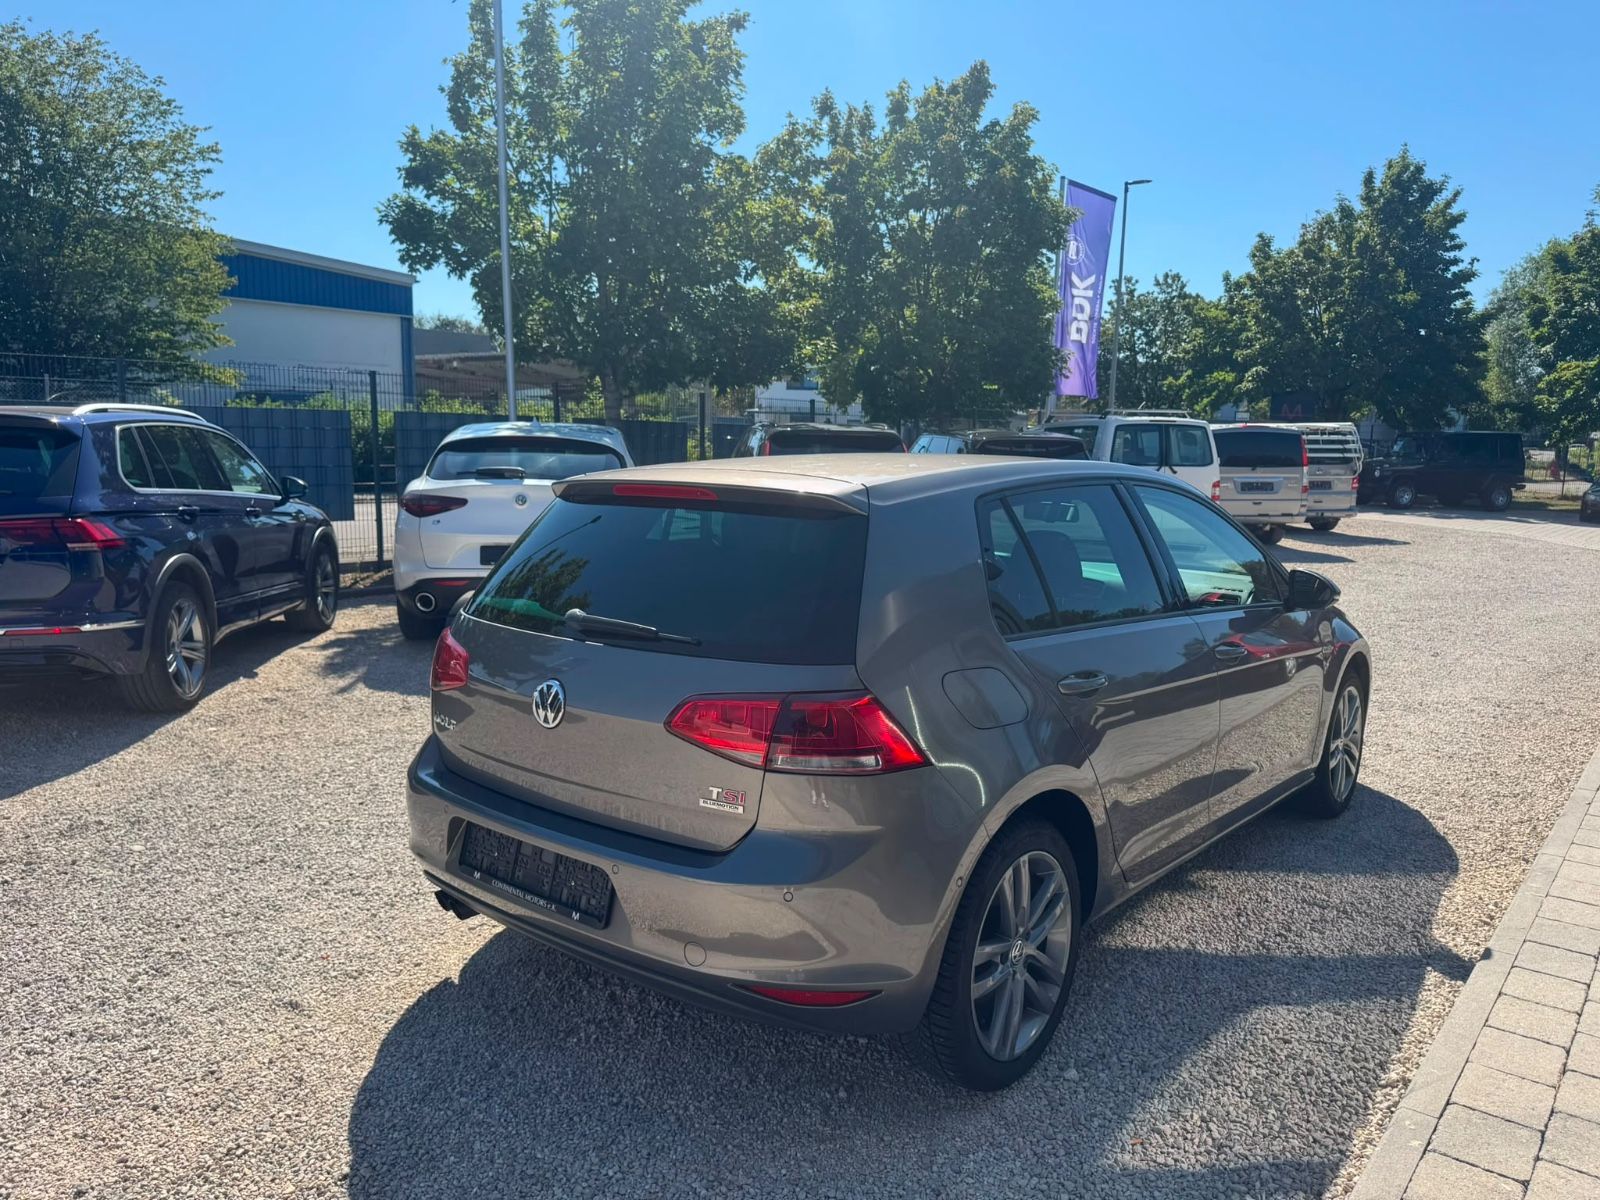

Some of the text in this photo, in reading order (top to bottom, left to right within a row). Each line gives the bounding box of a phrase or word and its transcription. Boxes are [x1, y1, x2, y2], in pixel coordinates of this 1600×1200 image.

[1070, 272, 1096, 344] BDK
[702, 799, 739, 811] BLUEMOTION
[708, 786, 746, 804] TSI
[492, 879, 525, 898] CONTINENTAL
[525, 894, 547, 907] MOTORS
